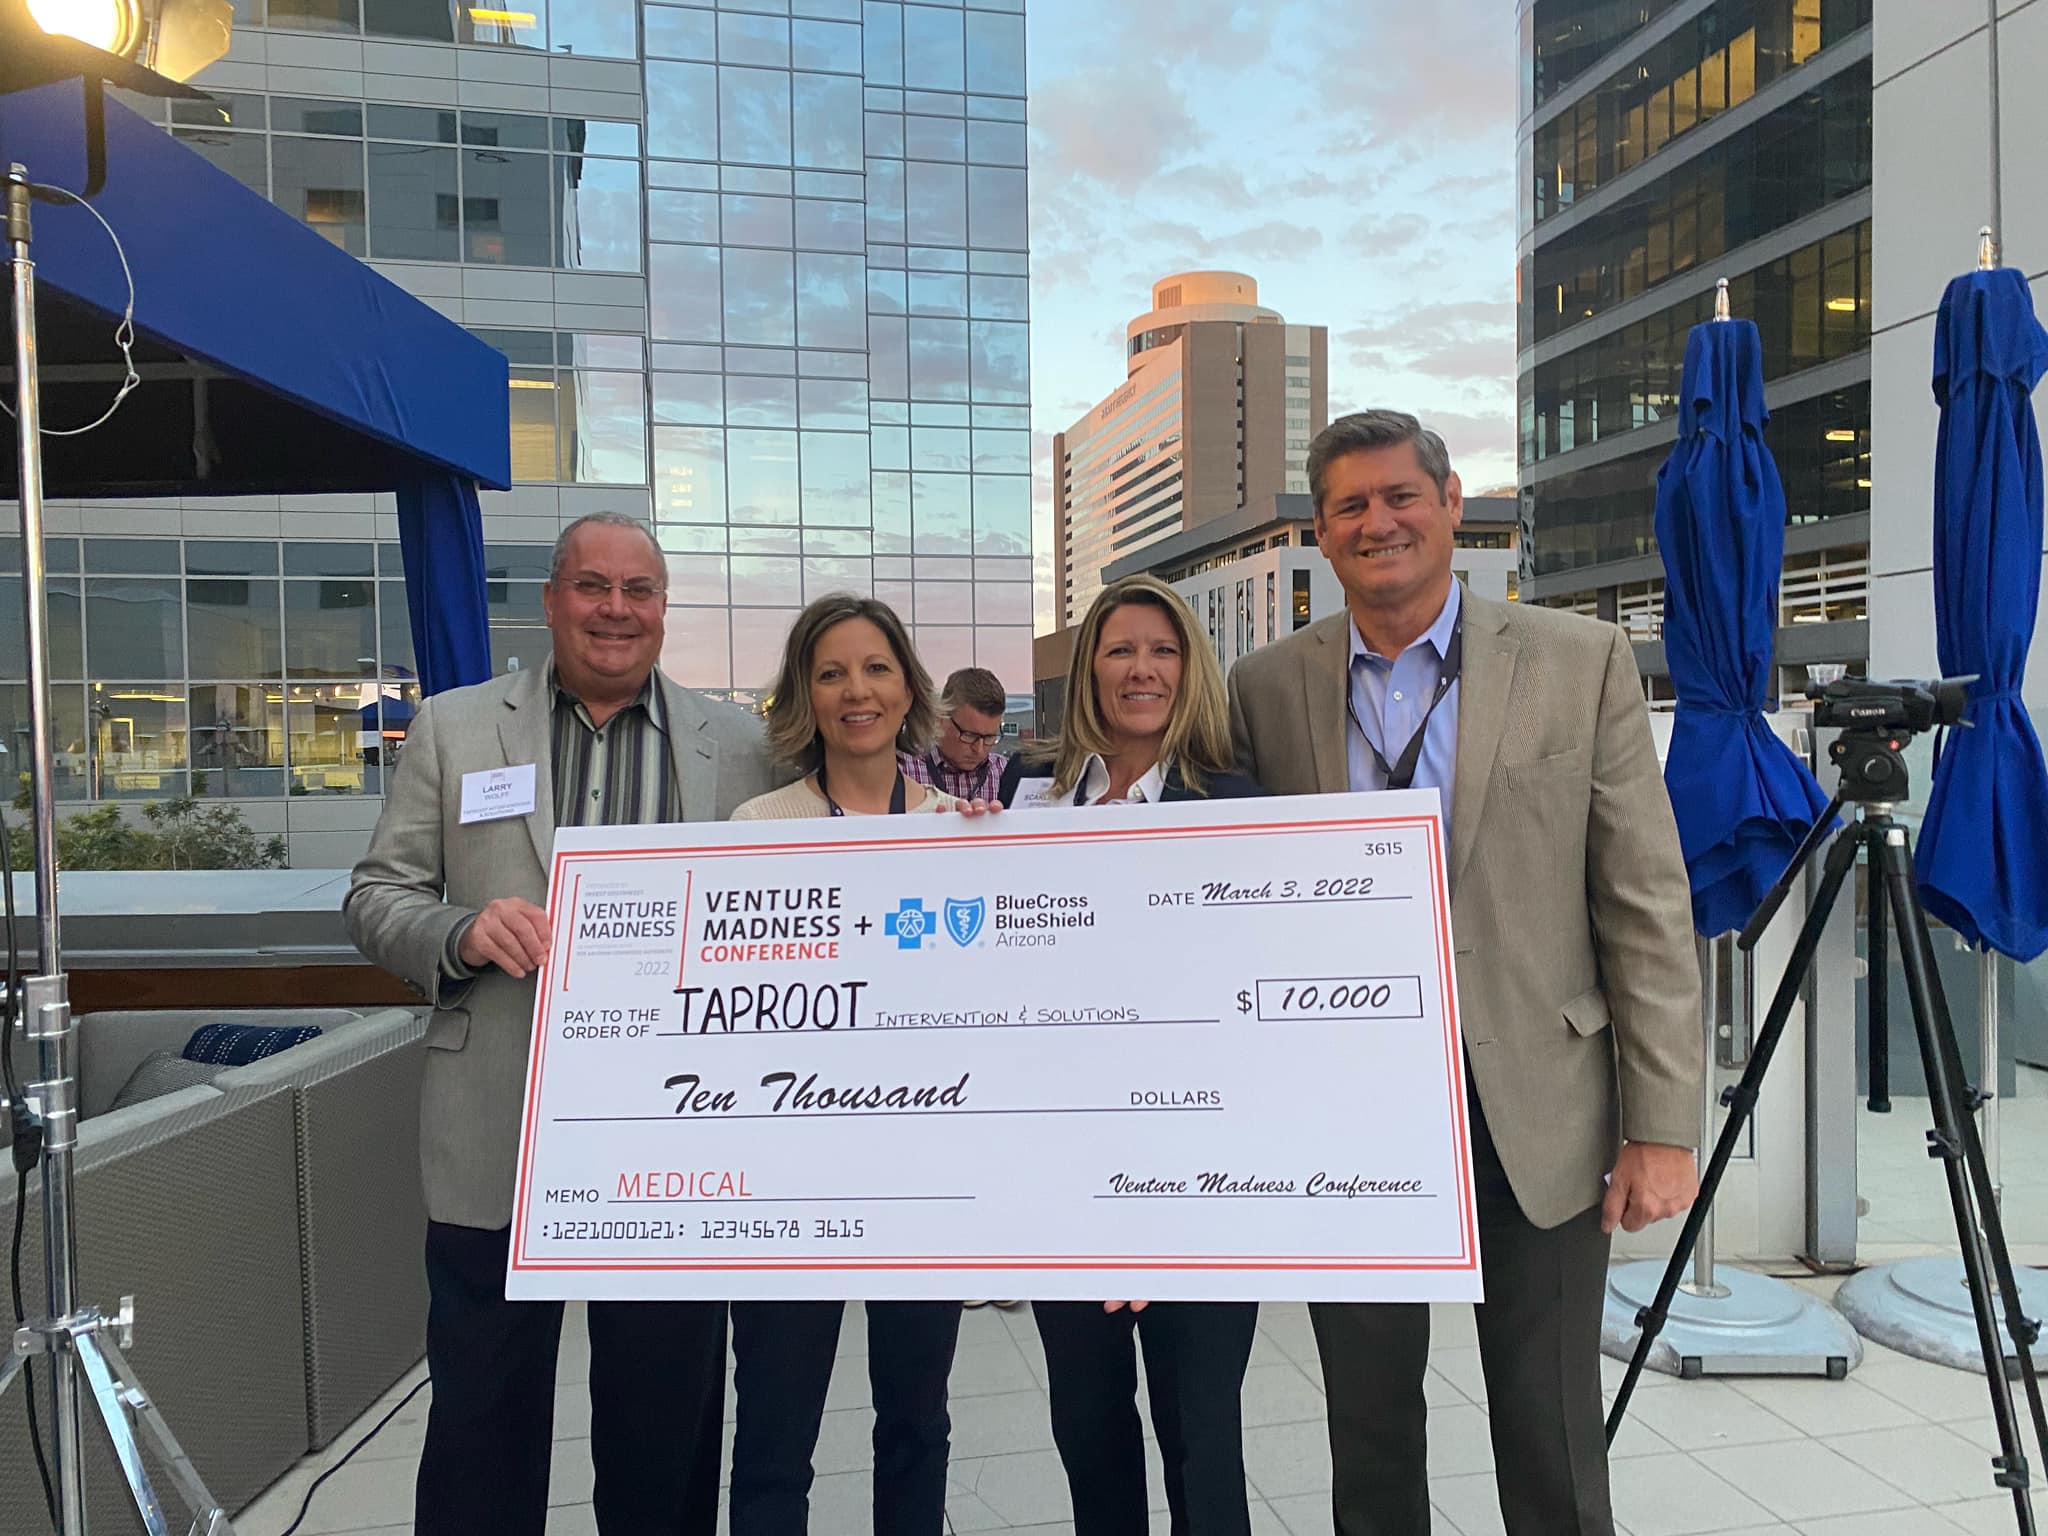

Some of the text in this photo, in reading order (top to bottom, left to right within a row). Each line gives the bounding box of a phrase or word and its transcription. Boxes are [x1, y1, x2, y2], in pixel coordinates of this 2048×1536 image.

[1851, 708, 1885, 717] Canon
[482, 783, 513, 794] LARRY
[1366, 842, 1402, 855] 3615
[705, 887, 842, 913] VENTURE
[1149, 892, 1195, 906] DATE
[1201, 881, 1273, 901] March
[1314, 878, 1373, 897] 2022
[584, 901, 677, 919] VENTURE
[996, 894, 1088, 910] BlueCross
[703, 914, 841, 941] MADNESS
[996, 911, 1094, 929] BlueShield
[579, 920, 676, 939] MADNESS
[996, 932, 1056, 947] Arizona
[700, 942, 839, 963] CONFERENCE
[634, 961, 670, 976] 2022
[673, 981, 868, 1033] TAPROOT
[1037, 1006, 1140, 1023] SOLUTIONS
[1237, 990, 1253, 1014] $
[564, 1008, 661, 1023] PAY TO THE
[562, 1025, 650, 1039] ORDER OF
[664, 1072, 970, 1114] Ten Thousand
[1130, 1091, 1221, 1105] DOLLARS
[545, 1172, 752, 1202] MEMO MEDICAL
[1109, 1172, 1423, 1198] Venture Madness Conference
[701, 1220, 799, 1238] 12345678
[814, 1220, 863, 1238] 3615
